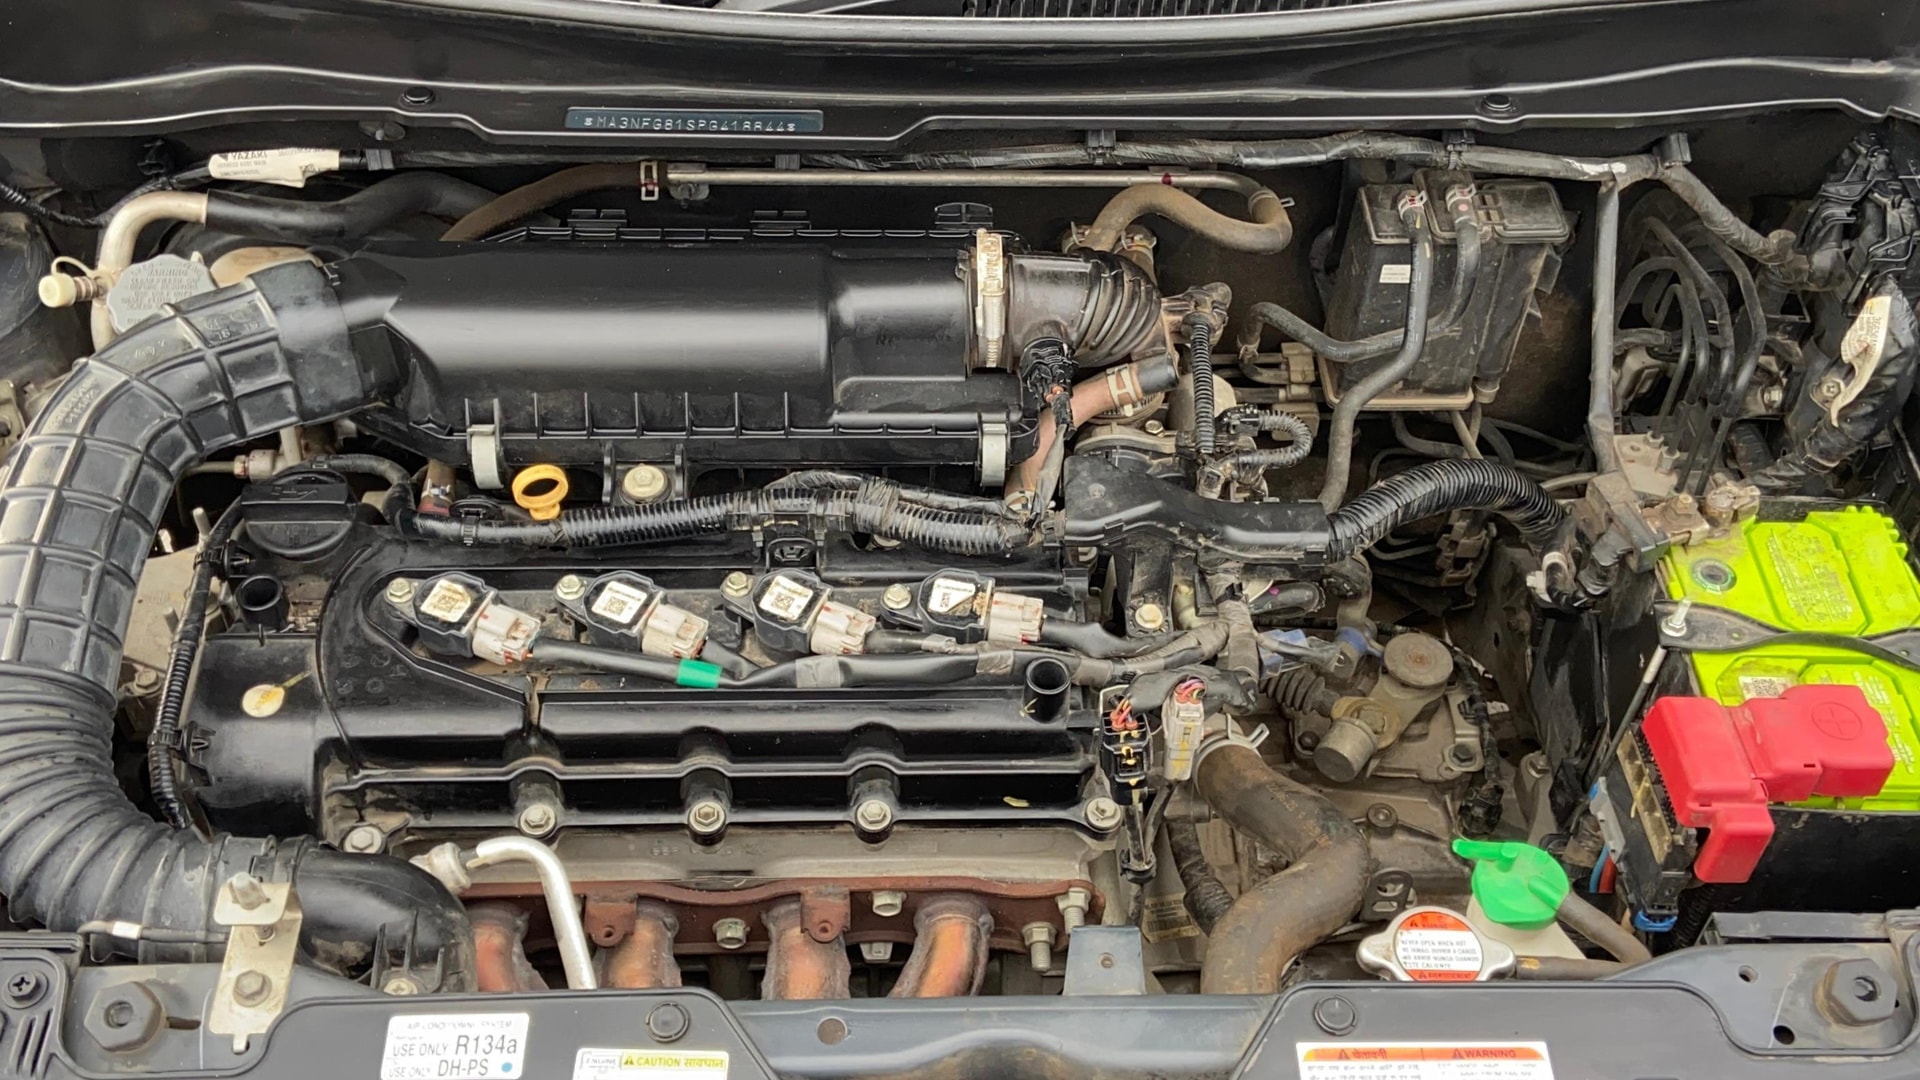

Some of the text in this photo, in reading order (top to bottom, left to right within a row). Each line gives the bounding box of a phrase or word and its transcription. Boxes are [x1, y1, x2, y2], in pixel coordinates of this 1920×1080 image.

[392, 1034, 518, 1057] USE ONLY R134a
[1351, 1048, 1388, 1060] चेतावनी
[1463, 1048, 1517, 1059] WARNING
[636, 1057, 680, 1067] CAUTION
[684, 1057, 724, 1068] सावधान
[388, 1058, 489, 1078] USE ONLY DH-PS
